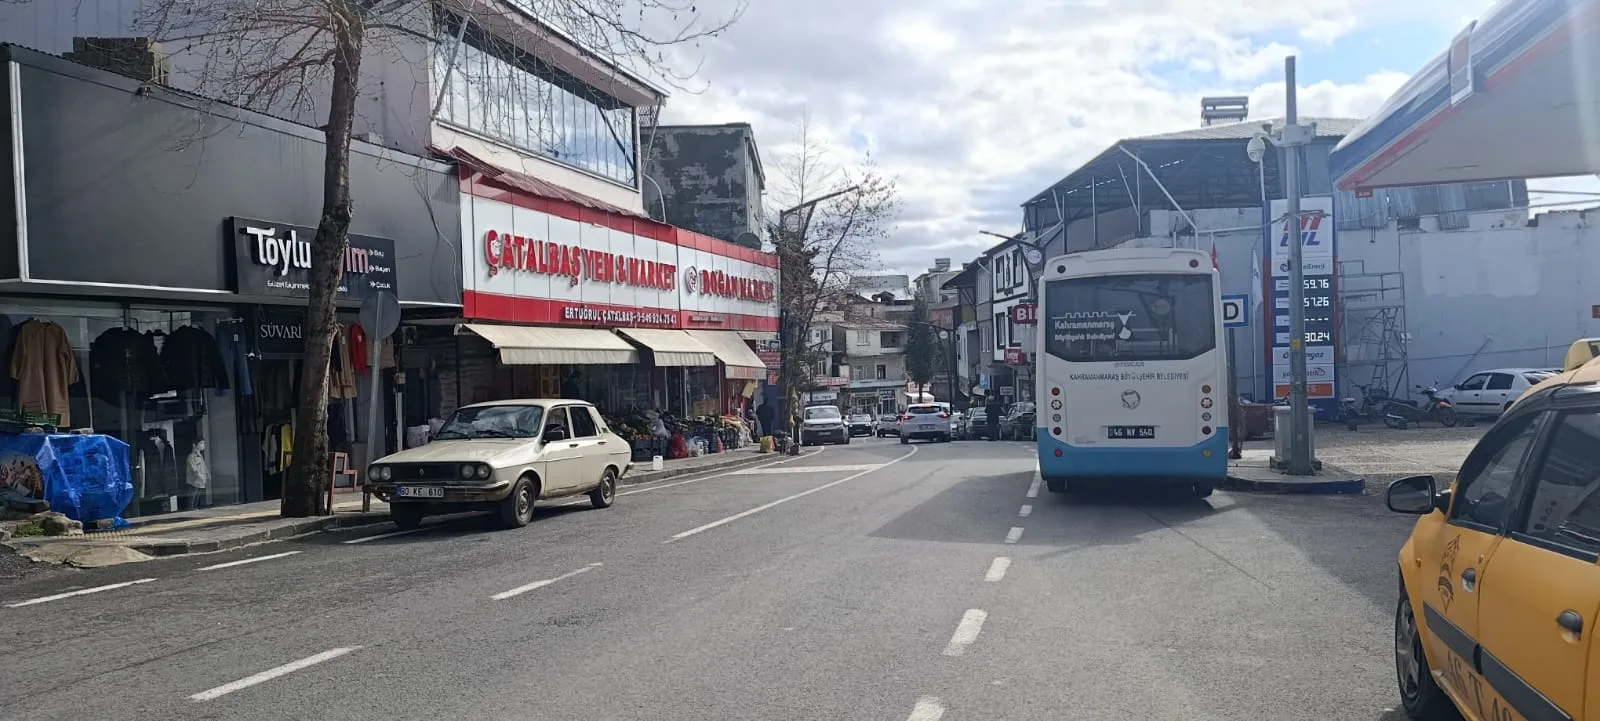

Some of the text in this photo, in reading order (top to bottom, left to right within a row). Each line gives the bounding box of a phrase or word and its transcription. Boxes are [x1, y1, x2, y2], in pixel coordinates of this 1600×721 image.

[246, 226, 312, 276] Toylu
[485, 229, 581, 286] ÇATALBAŞ
[616, 254, 627, 284] &
[628, 257, 677, 291] MARKET
[700, 269, 738, 299] DOĞAN
[1304, 279, 1329, 289] 59.76
[1304, 297, 1329, 307] 57.26
[565, 305, 601, 320] ERTUĞRUL
[1016, 304, 1038, 321] Bİ
[1223, 302, 1239, 321] D
[1054, 320, 1115, 330] Kahramanmaraş
[1305, 332, 1330, 342] 30.24
[1069, 372, 1120, 381] KAHRAMANMARAŞ
[1156, 371, 1189, 380] BELEDİYESİ
[413, 487, 423, 497] KE
[428, 488, 443, 497] 610
